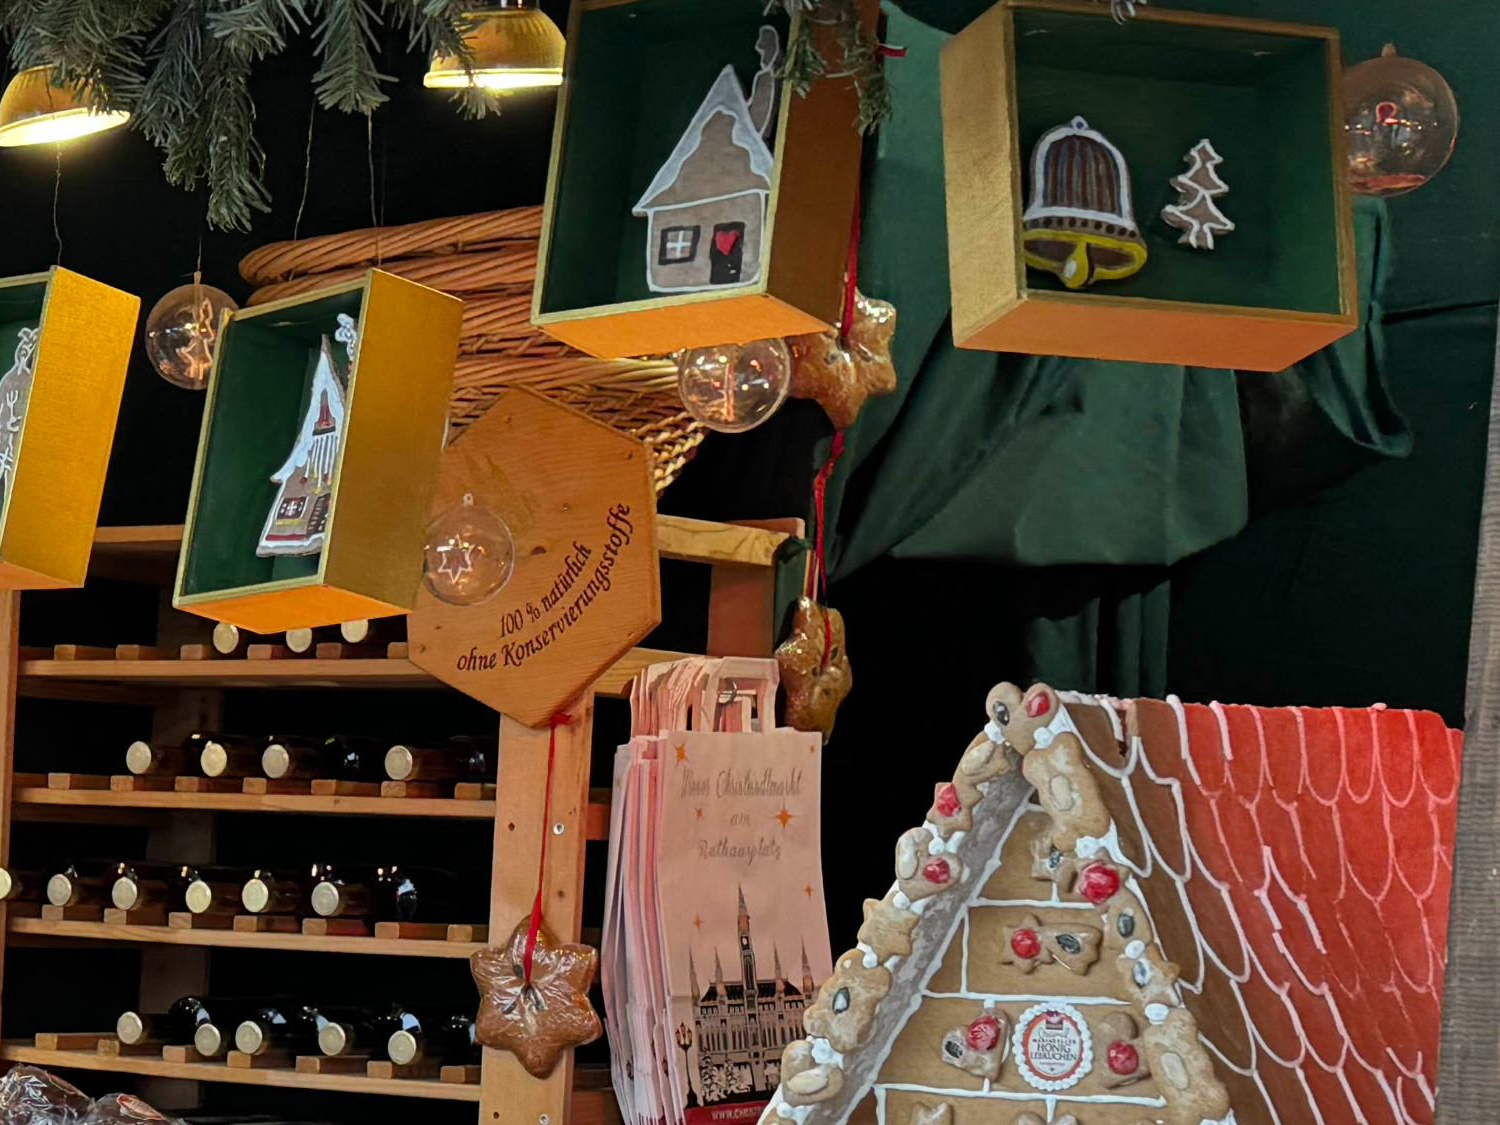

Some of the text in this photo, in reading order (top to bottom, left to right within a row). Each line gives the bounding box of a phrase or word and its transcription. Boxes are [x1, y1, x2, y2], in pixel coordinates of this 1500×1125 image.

[456, 503, 634, 672] ohne Konservierungsstoffe
[500, 541, 593, 638] 100 % natürlich
[730, 813, 750, 826] am
[699, 836, 782, 867] Rathausplatz
[1036, 1043, 1071, 1054] HONIG
